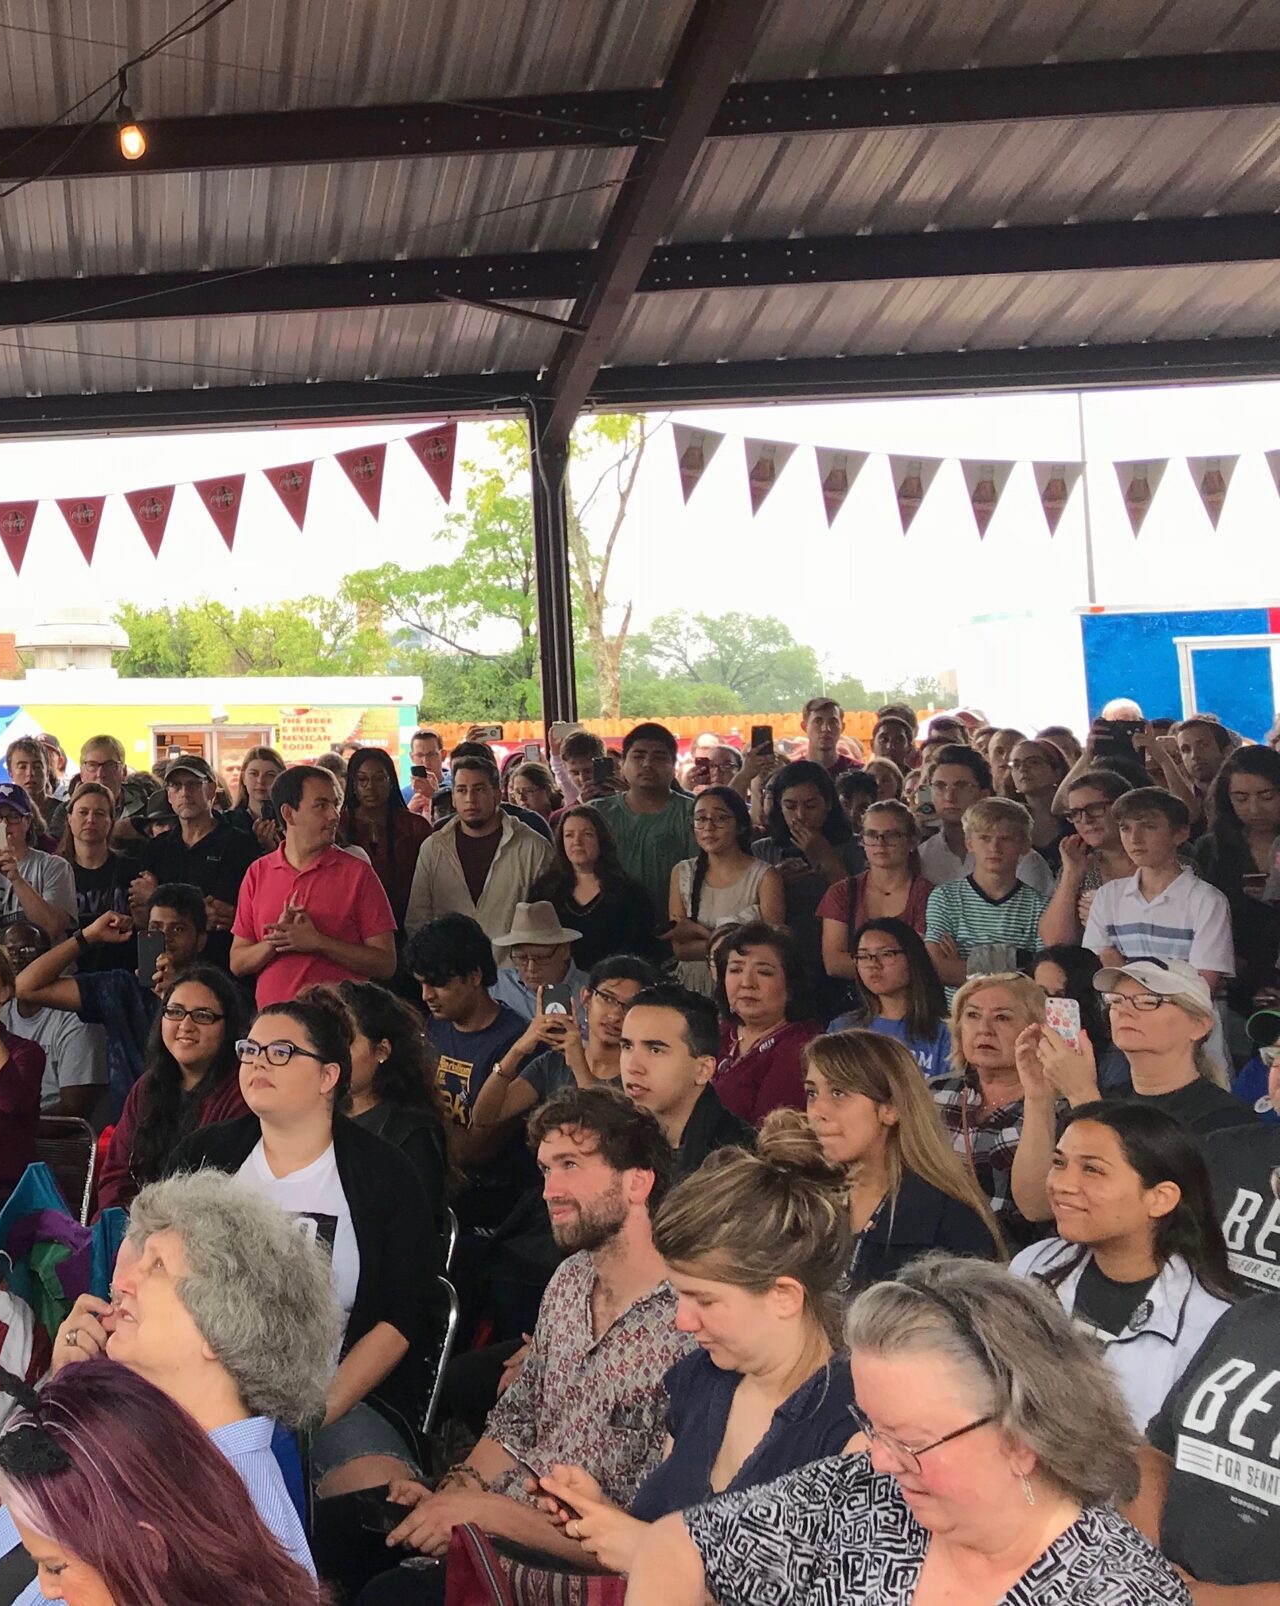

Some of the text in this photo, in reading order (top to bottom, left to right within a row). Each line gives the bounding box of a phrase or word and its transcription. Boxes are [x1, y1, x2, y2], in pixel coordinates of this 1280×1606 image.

[1238, 1259, 1262, 1275] FOR
[1182, 1357, 1280, 1460] BE
[1215, 1453, 1241, 1482] FOR
